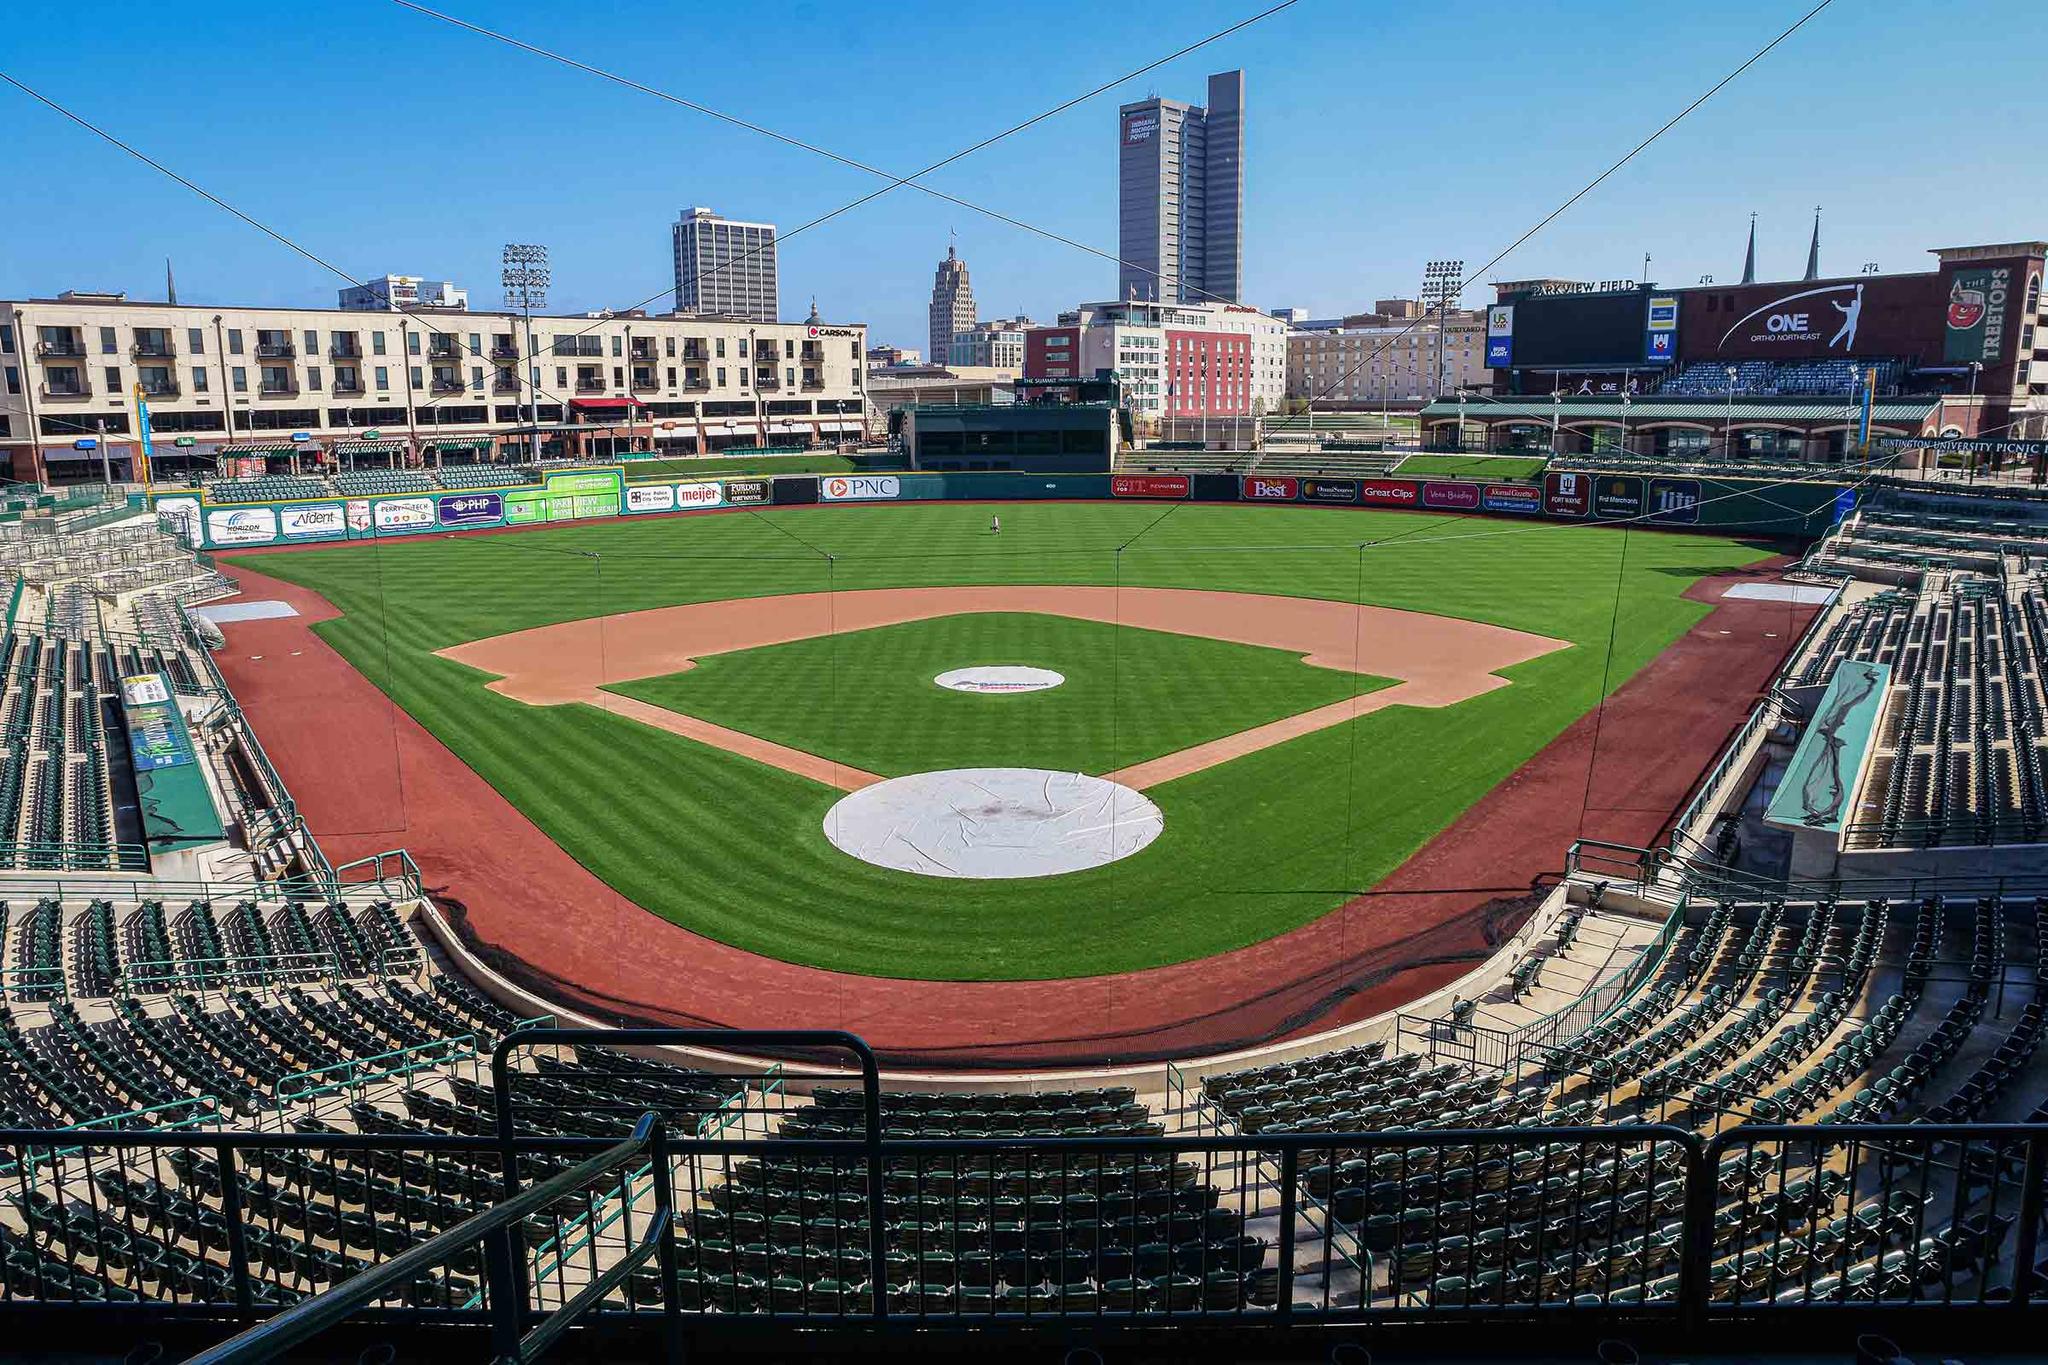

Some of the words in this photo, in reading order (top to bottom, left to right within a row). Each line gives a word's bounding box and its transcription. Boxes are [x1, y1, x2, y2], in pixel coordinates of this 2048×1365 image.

[1130, 132, 1150, 140] POWER
[1531, 282, 1595, 297] PARKVIEW
[1600, 280, 1634, 292] FIELD
[1965, 279, 1985, 288] THE
[1983, 268, 2009, 359] TREETOPS
[1766, 313, 1809, 333] ONE
[819, 329, 851, 337] CARSON
[1751, 334, 1776, 342] ORTHO
[1777, 333, 1821, 341] NORTHEAST
[1601, 383, 1617, 391] ONE
[1880, 438, 1931, 449] HUNTINGTON
[1933, 442, 1992, 452] UNIVERSITY
[1996, 443, 2039, 454] PICNIC
[731, 483, 761, 492] PURDUE
[852, 479, 892, 494] PNC
[1116, 480, 1128, 488] GO
[1254, 481, 1287, 497] Best
[682, 487, 717, 502] meijer
[1364, 488, 1391, 498] Great
[1391, 488, 1414, 500] Clips
[1430, 491, 1446, 499] Vera
[1447, 490, 1473, 501] Bradley
[468, 499, 489, 510] PHP
[296, 511, 334, 525] Afdent
